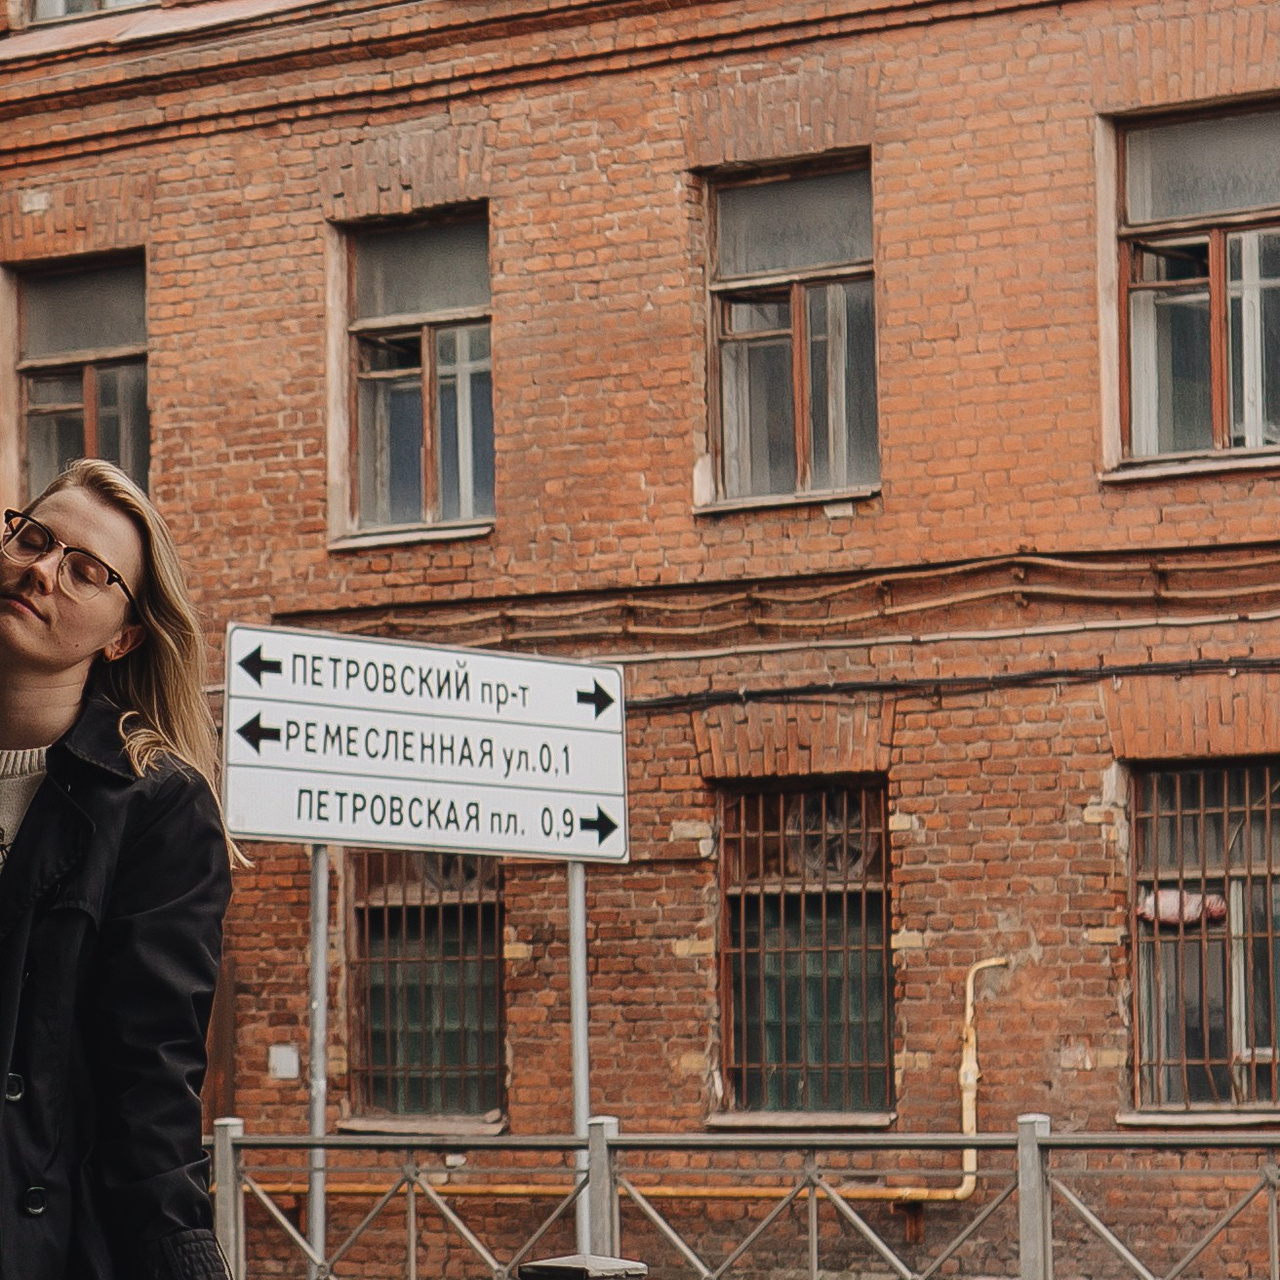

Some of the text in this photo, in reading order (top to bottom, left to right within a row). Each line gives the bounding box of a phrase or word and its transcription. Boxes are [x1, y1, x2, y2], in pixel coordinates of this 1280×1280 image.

[292, 652, 530, 714] ПЕТРОВСКИЙ пр-т
[285, 719, 495, 768] РЕМЕСЛЕННАЯ
[297, 787, 575, 839] ПЕТРОВСКАЯ пл. 0,9
